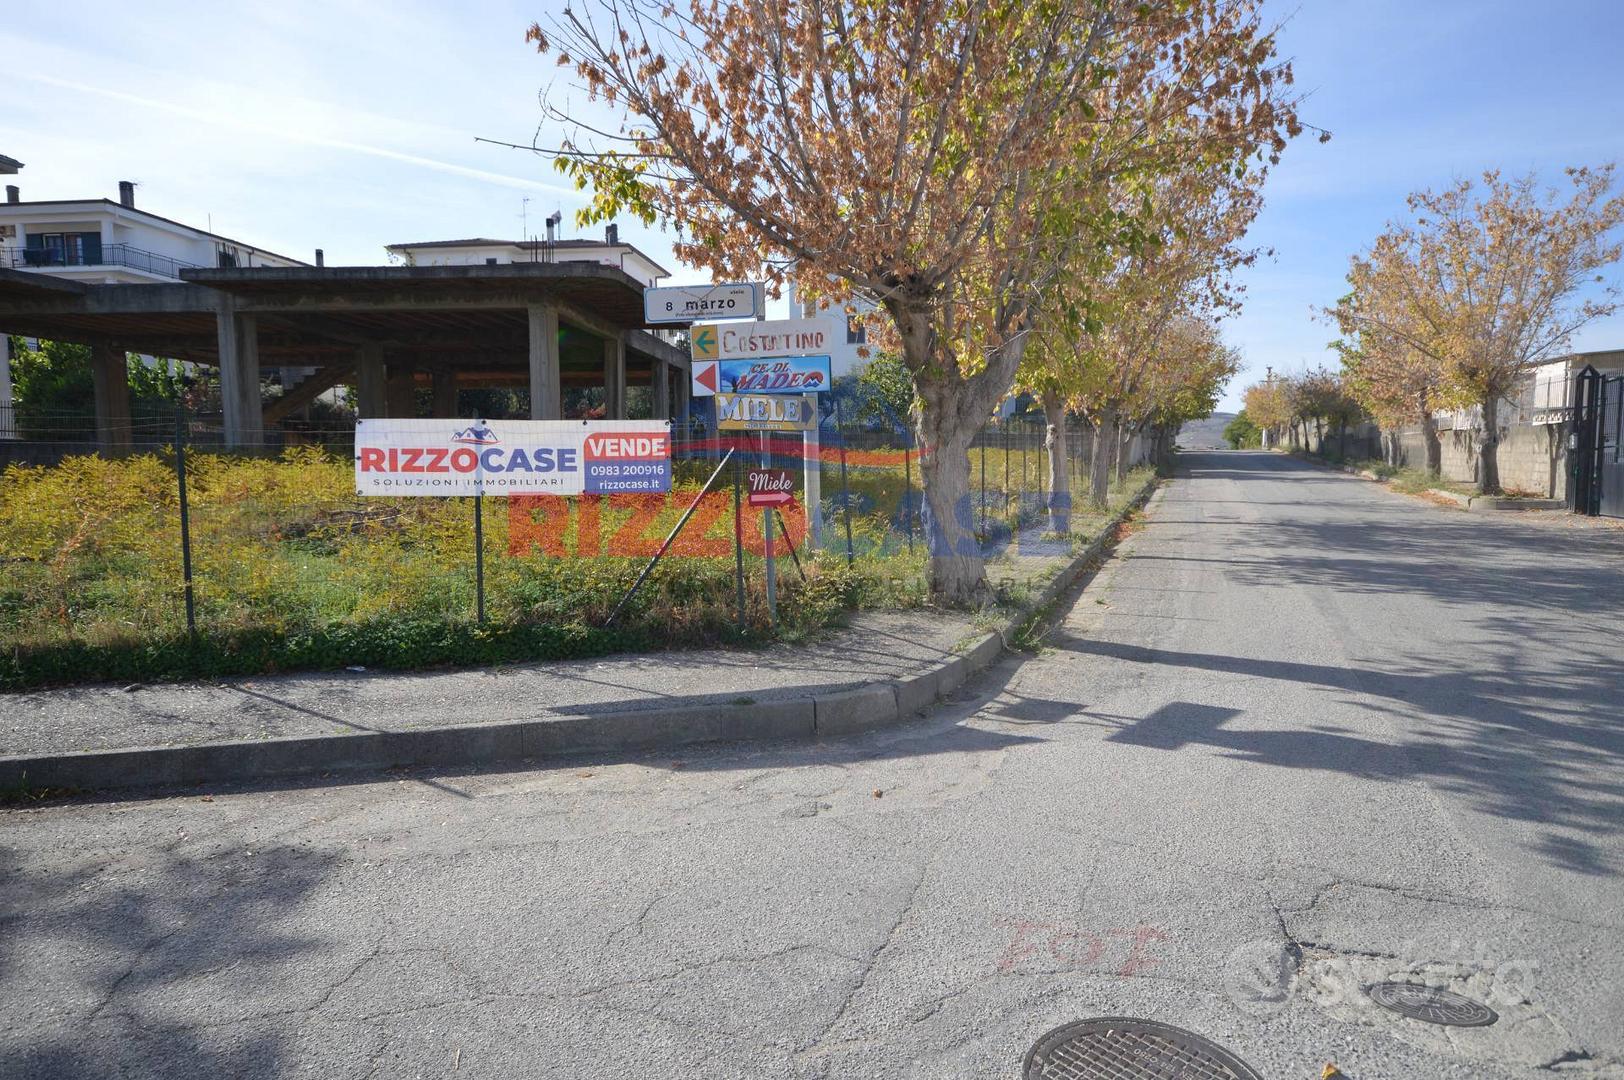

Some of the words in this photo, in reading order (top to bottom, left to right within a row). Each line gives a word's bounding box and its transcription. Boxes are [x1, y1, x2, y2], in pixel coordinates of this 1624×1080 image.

[665, 301, 673, 311] 8
[685, 298, 736, 311] marzo
[718, 396, 801, 422] MIELE
[588, 438, 666, 458] VENDE
[361, 447, 578, 473] RIZZOCASE
[591, 465, 620, 476] 0983
[623, 465, 665, 476] 200916
[373, 478, 459, 486] SOLUZIONI
[467, 478, 565, 486] IMMOBILIARI
[599, 478, 660, 490] rizzocase.it
[749, 471, 793, 491] Miele
